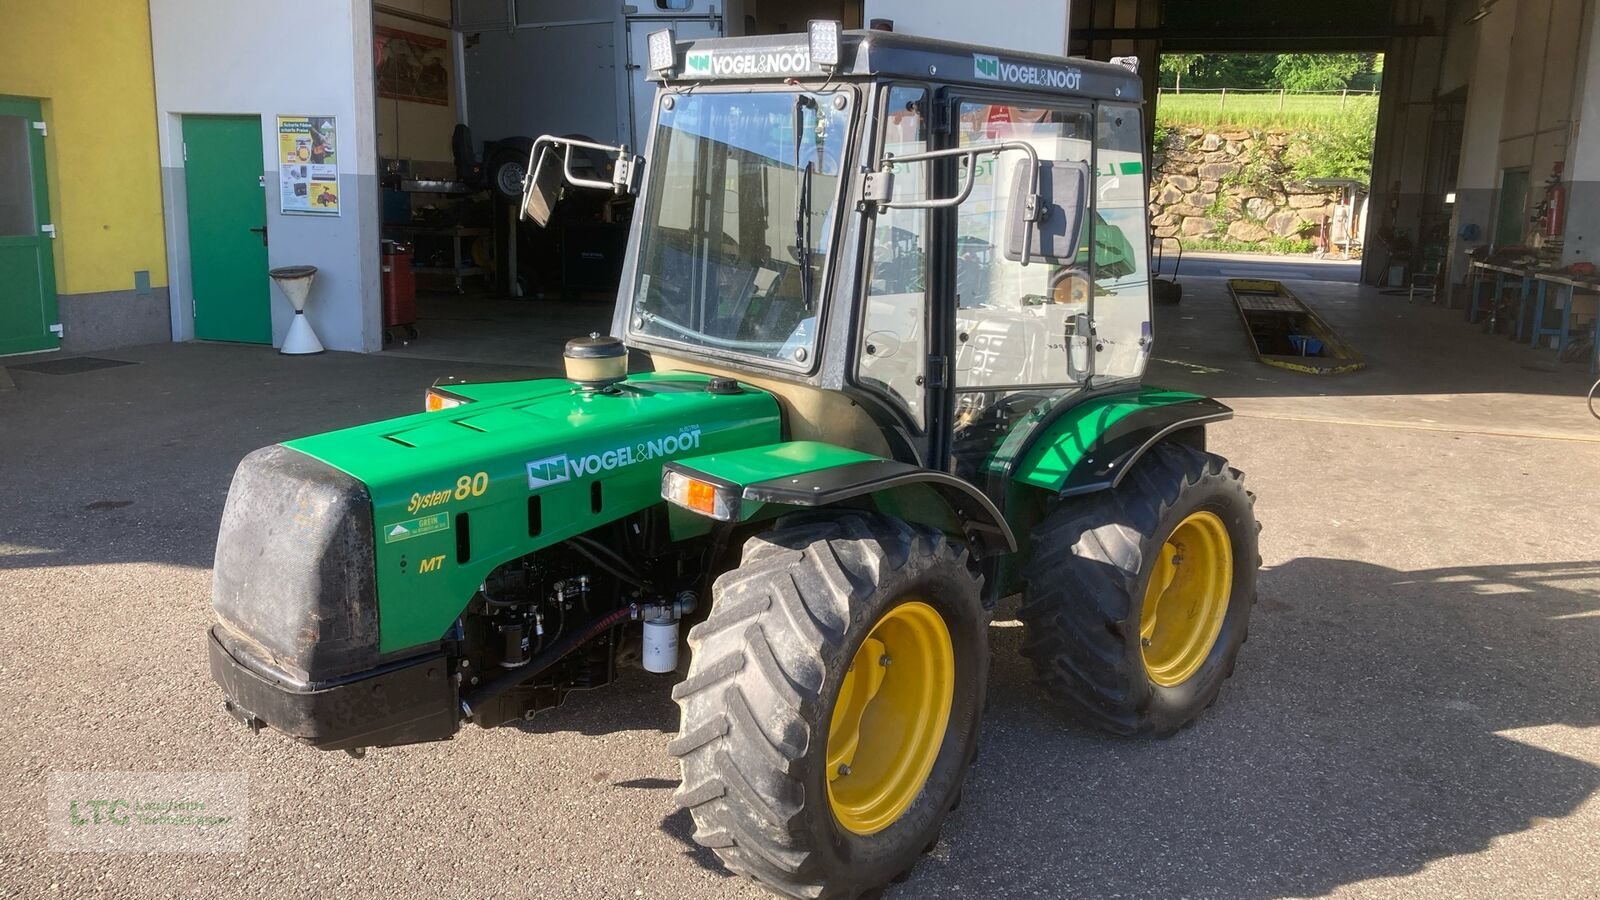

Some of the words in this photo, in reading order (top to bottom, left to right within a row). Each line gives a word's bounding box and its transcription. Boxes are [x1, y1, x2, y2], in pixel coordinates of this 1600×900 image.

[1000, 63, 1081, 90] VOGEL&NOOT
[569, 430, 702, 478] VOGEL&NOOT
[407, 489, 452, 515] System
[454, 471, 489, 500] 80
[419, 555, 446, 574] MT
